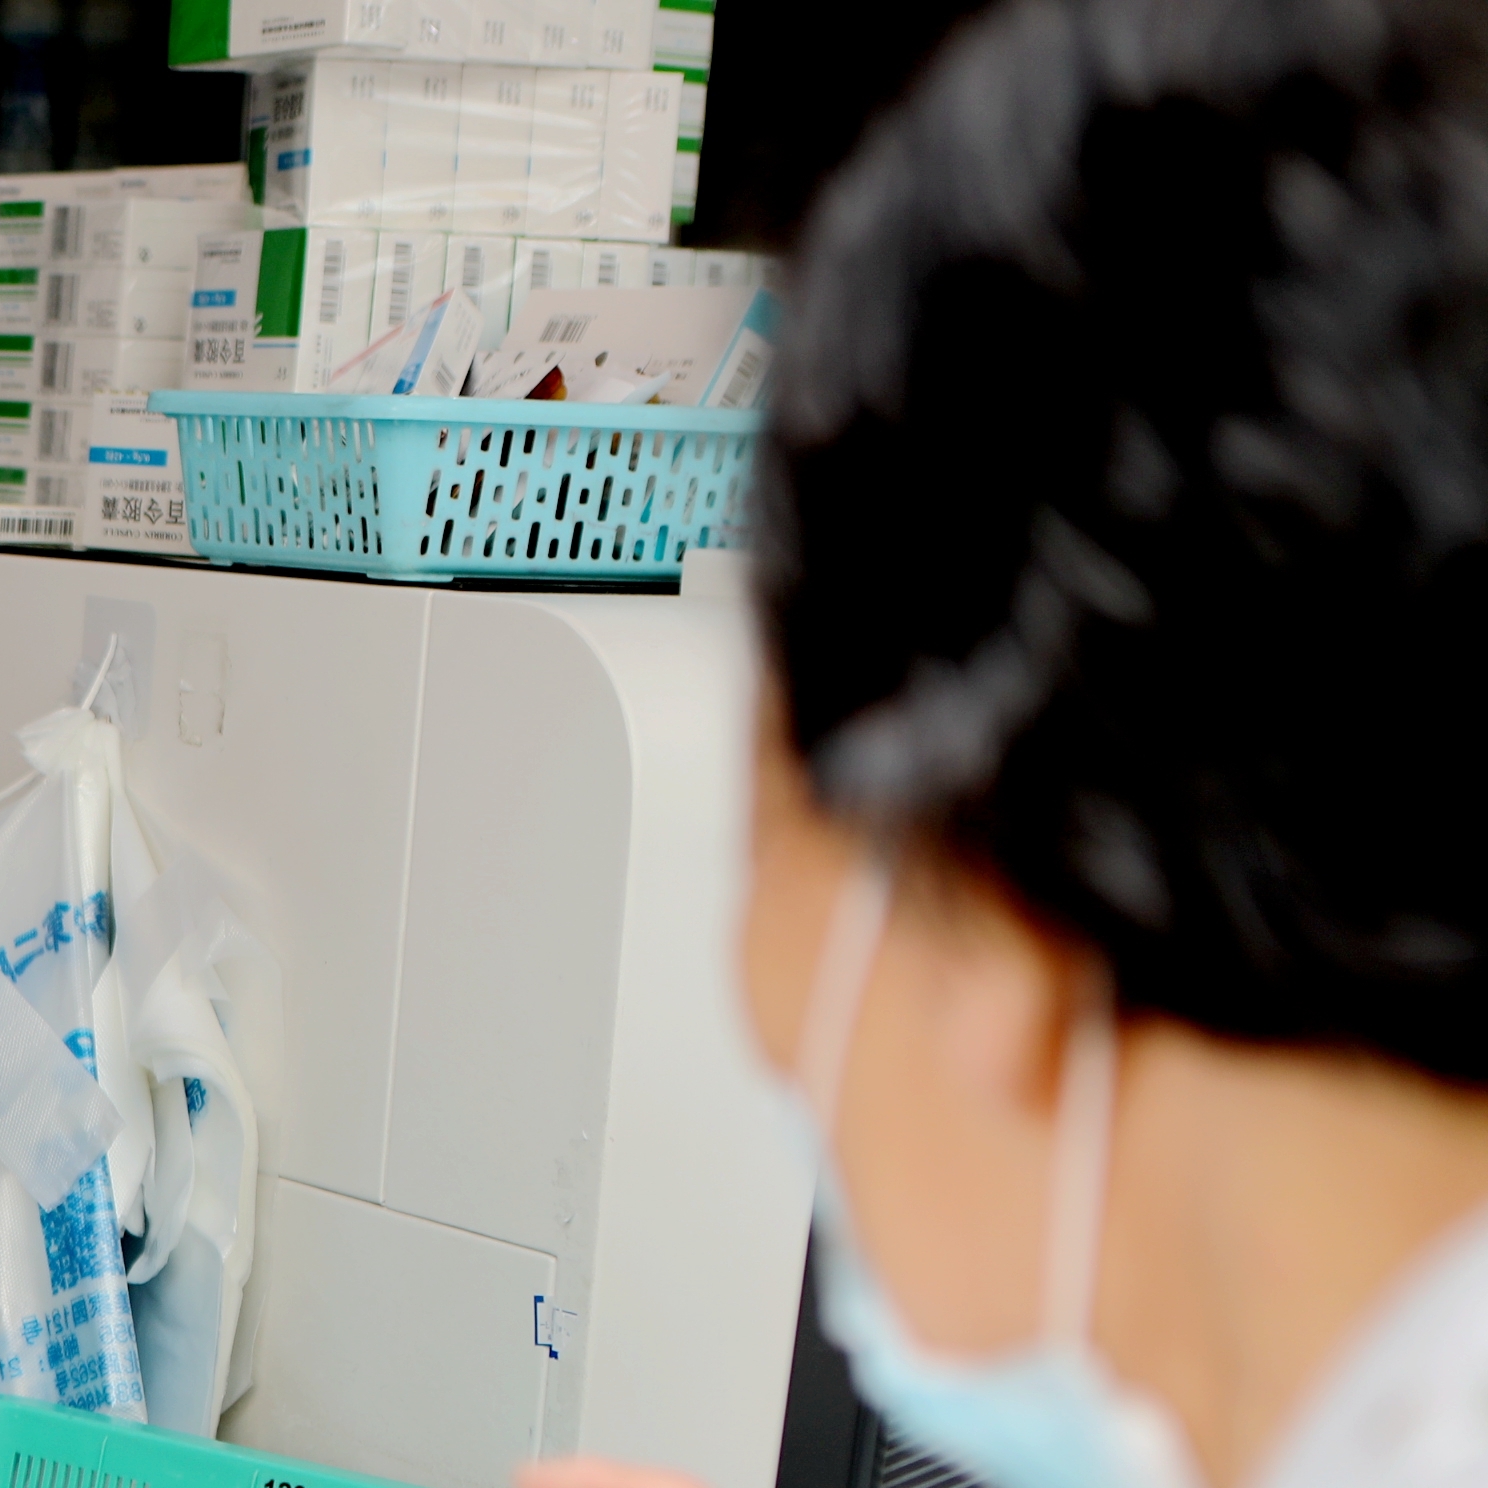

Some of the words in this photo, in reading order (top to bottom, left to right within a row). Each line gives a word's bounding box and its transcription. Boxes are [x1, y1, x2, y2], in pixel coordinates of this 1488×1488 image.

[102, 495, 185, 525] 百令胶囊
[104, 526, 141, 539] CAPSULE
